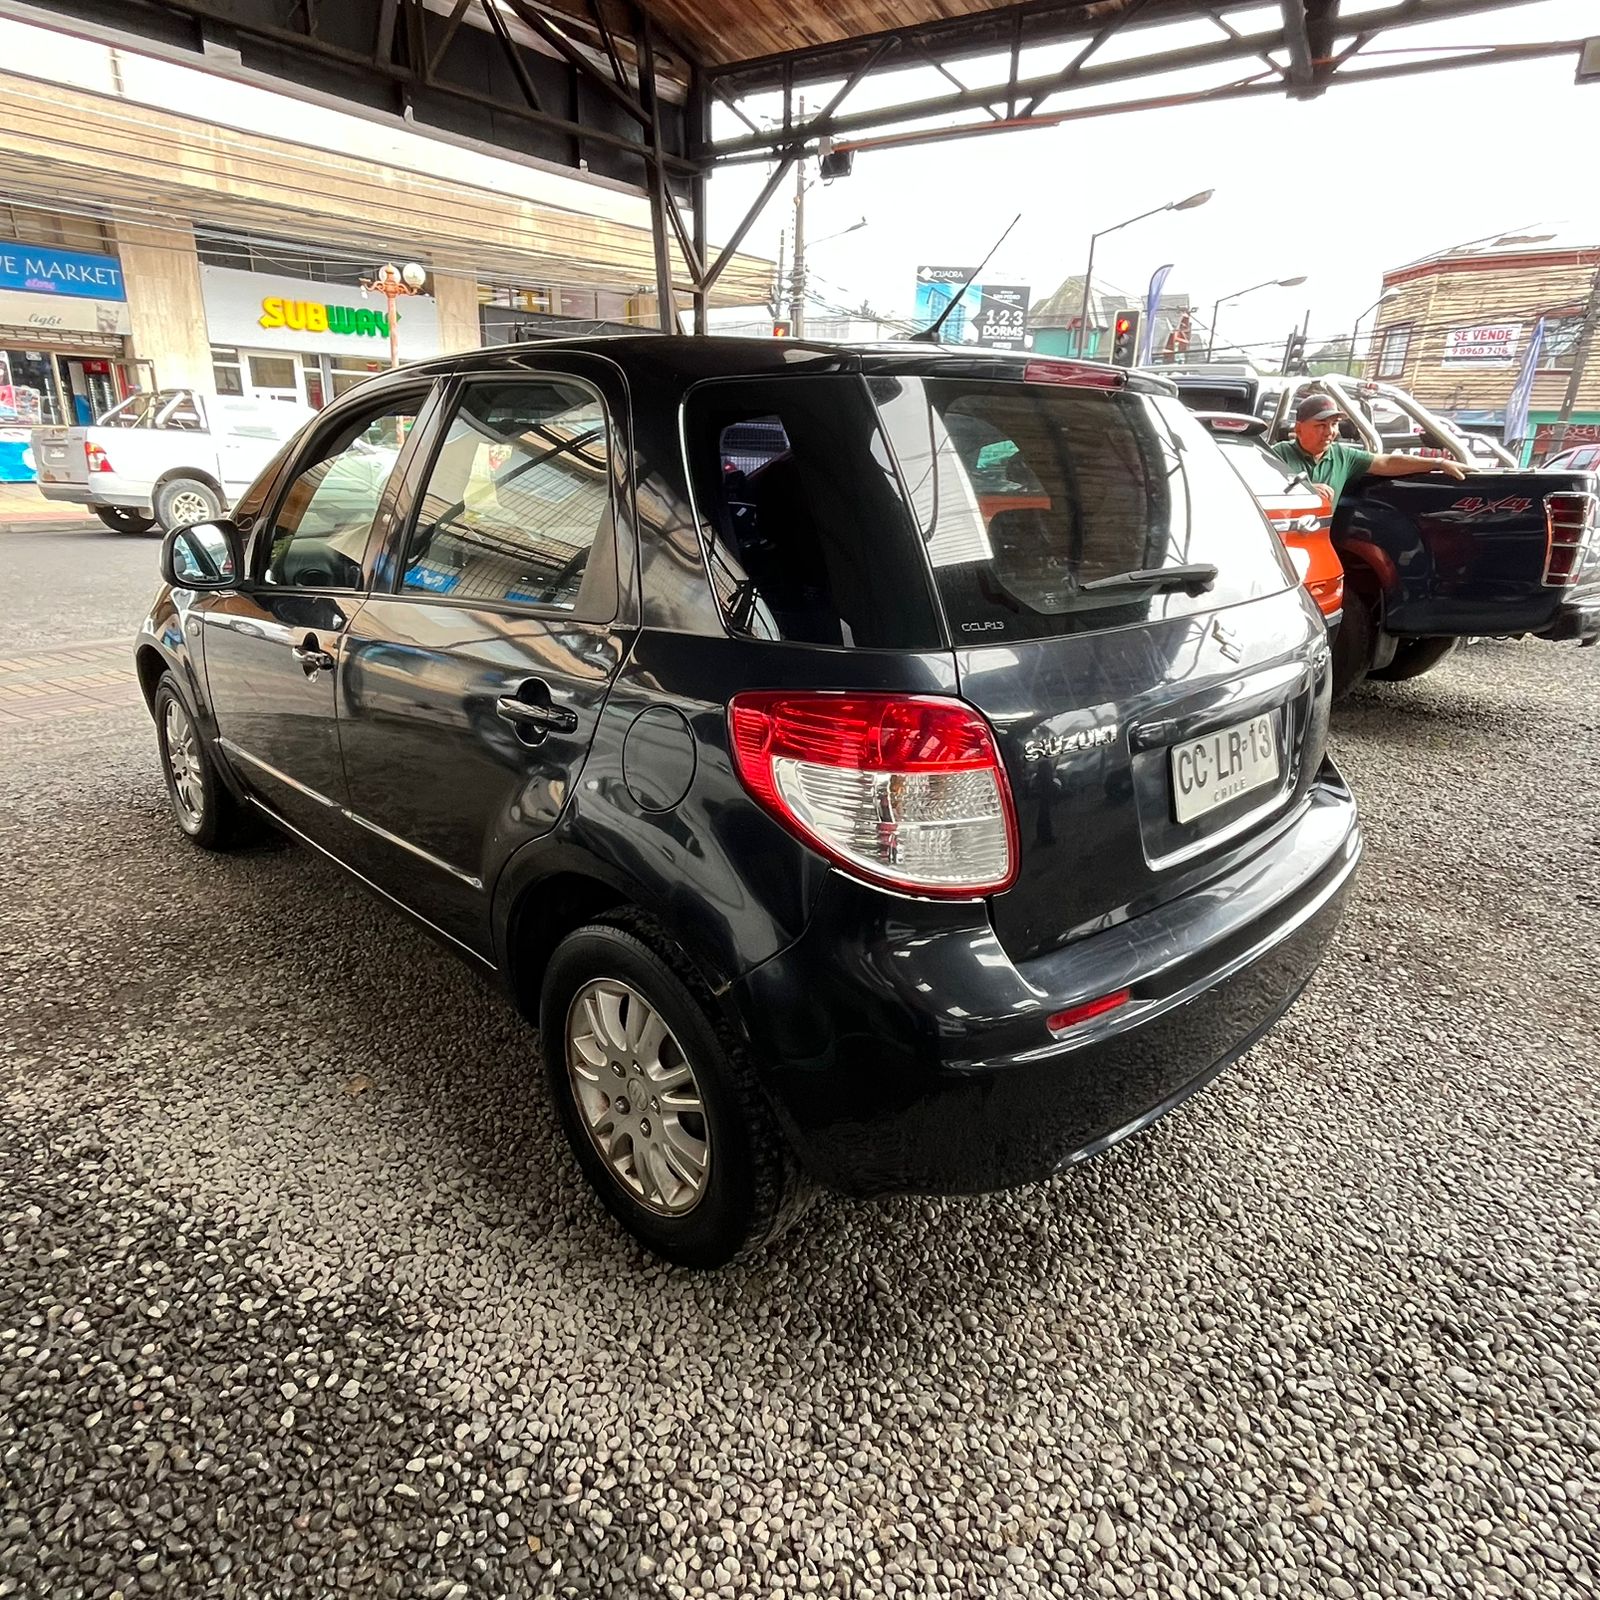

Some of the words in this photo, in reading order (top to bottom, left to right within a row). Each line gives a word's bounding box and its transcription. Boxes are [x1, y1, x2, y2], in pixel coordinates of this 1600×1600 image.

[25, 258, 120, 286] MARKET
[258, 296, 401, 339] SUBWAY
[982, 325, 1024, 337] DORMS
[1454, 330, 1468, 341] SE
[1473, 329, 1513, 341] VENDE
[961, 621, 1005, 632] CCLR13
[1023, 724, 1118, 763] SUZUKI
[1213, 777, 1248, 803] CHILE
